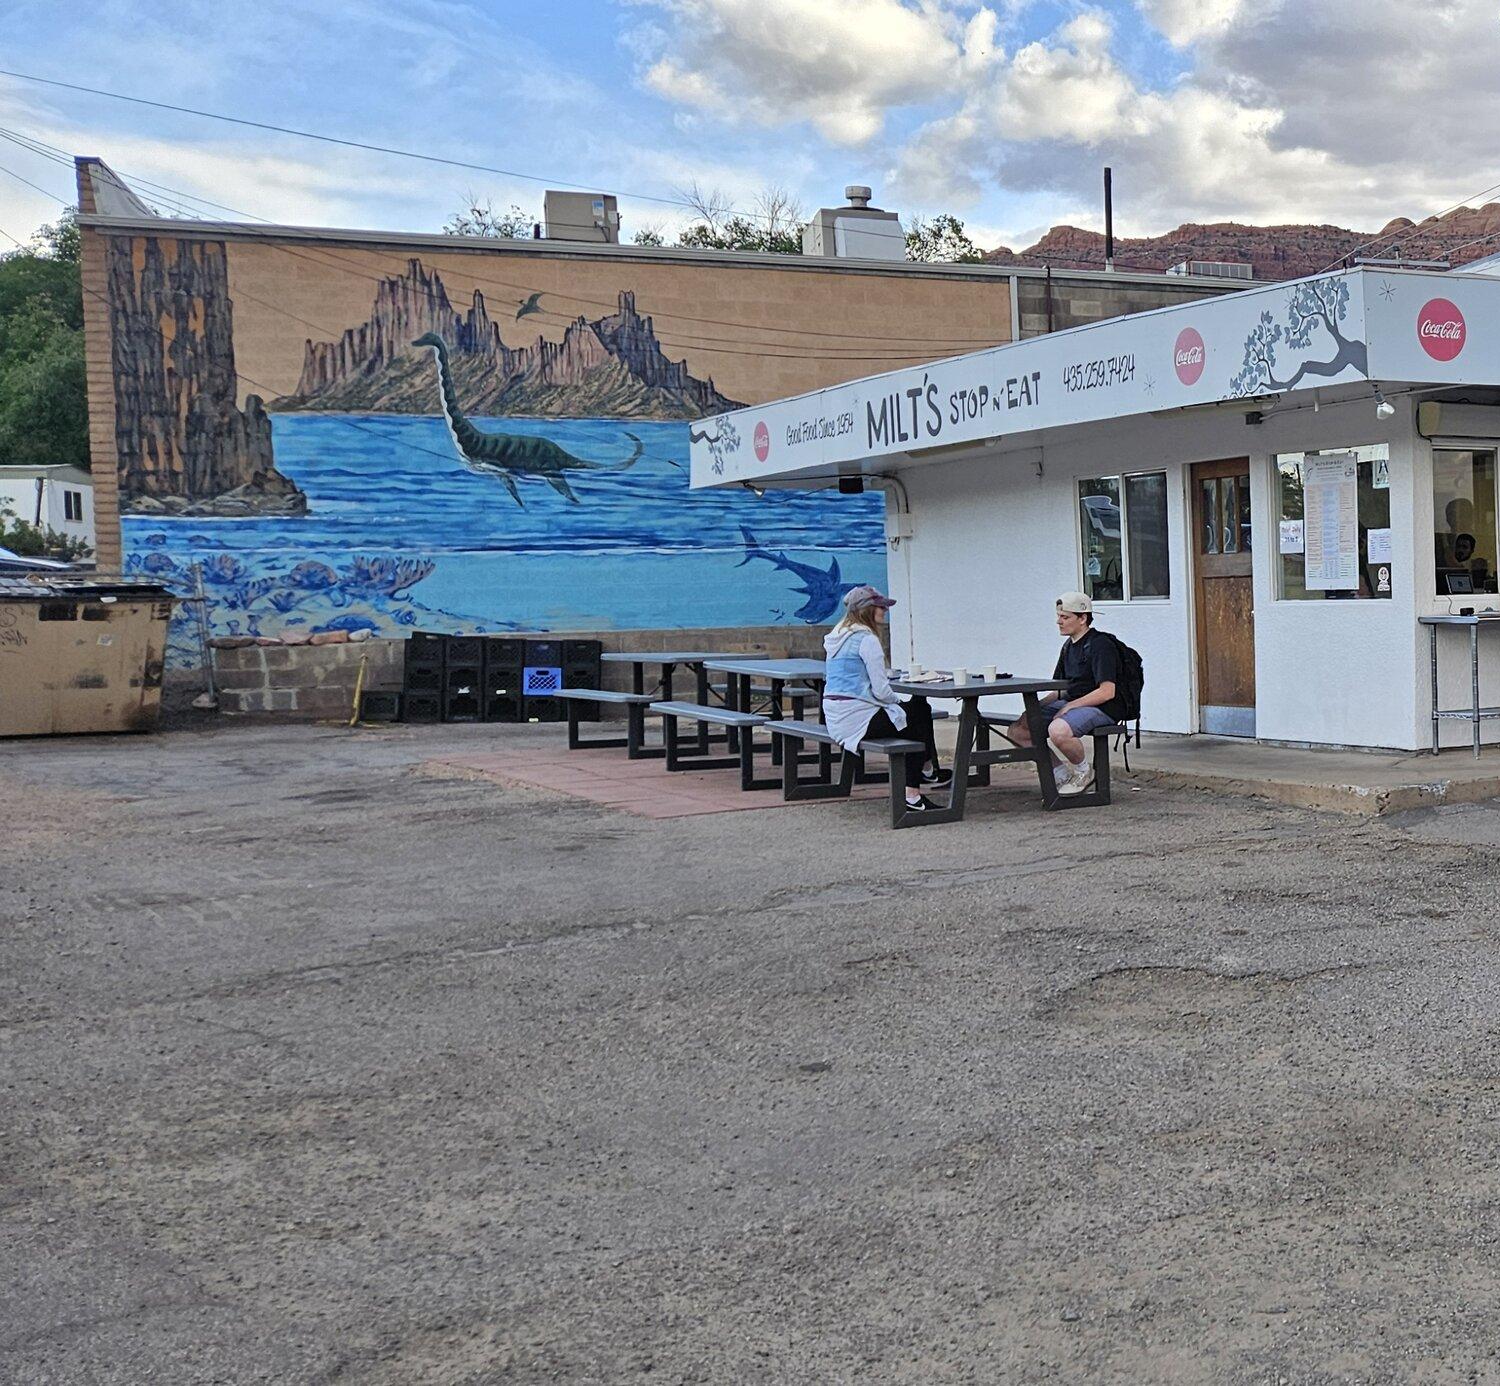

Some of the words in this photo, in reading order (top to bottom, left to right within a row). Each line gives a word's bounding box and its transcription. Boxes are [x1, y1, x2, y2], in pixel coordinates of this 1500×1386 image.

[1421, 319, 1463, 340] Coca-Cola
[1063, 353, 1136, 393] 435.259.7424
[866, 373, 942, 449] MILT'S
[949, 385, 989, 425] STOP
[1006, 371, 1041, 409] EAT
[786, 422, 801, 446] Good
[802, 418, 817, 443] Food
[819, 417, 836, 439] Since
[837, 412, 854, 436] 1954
